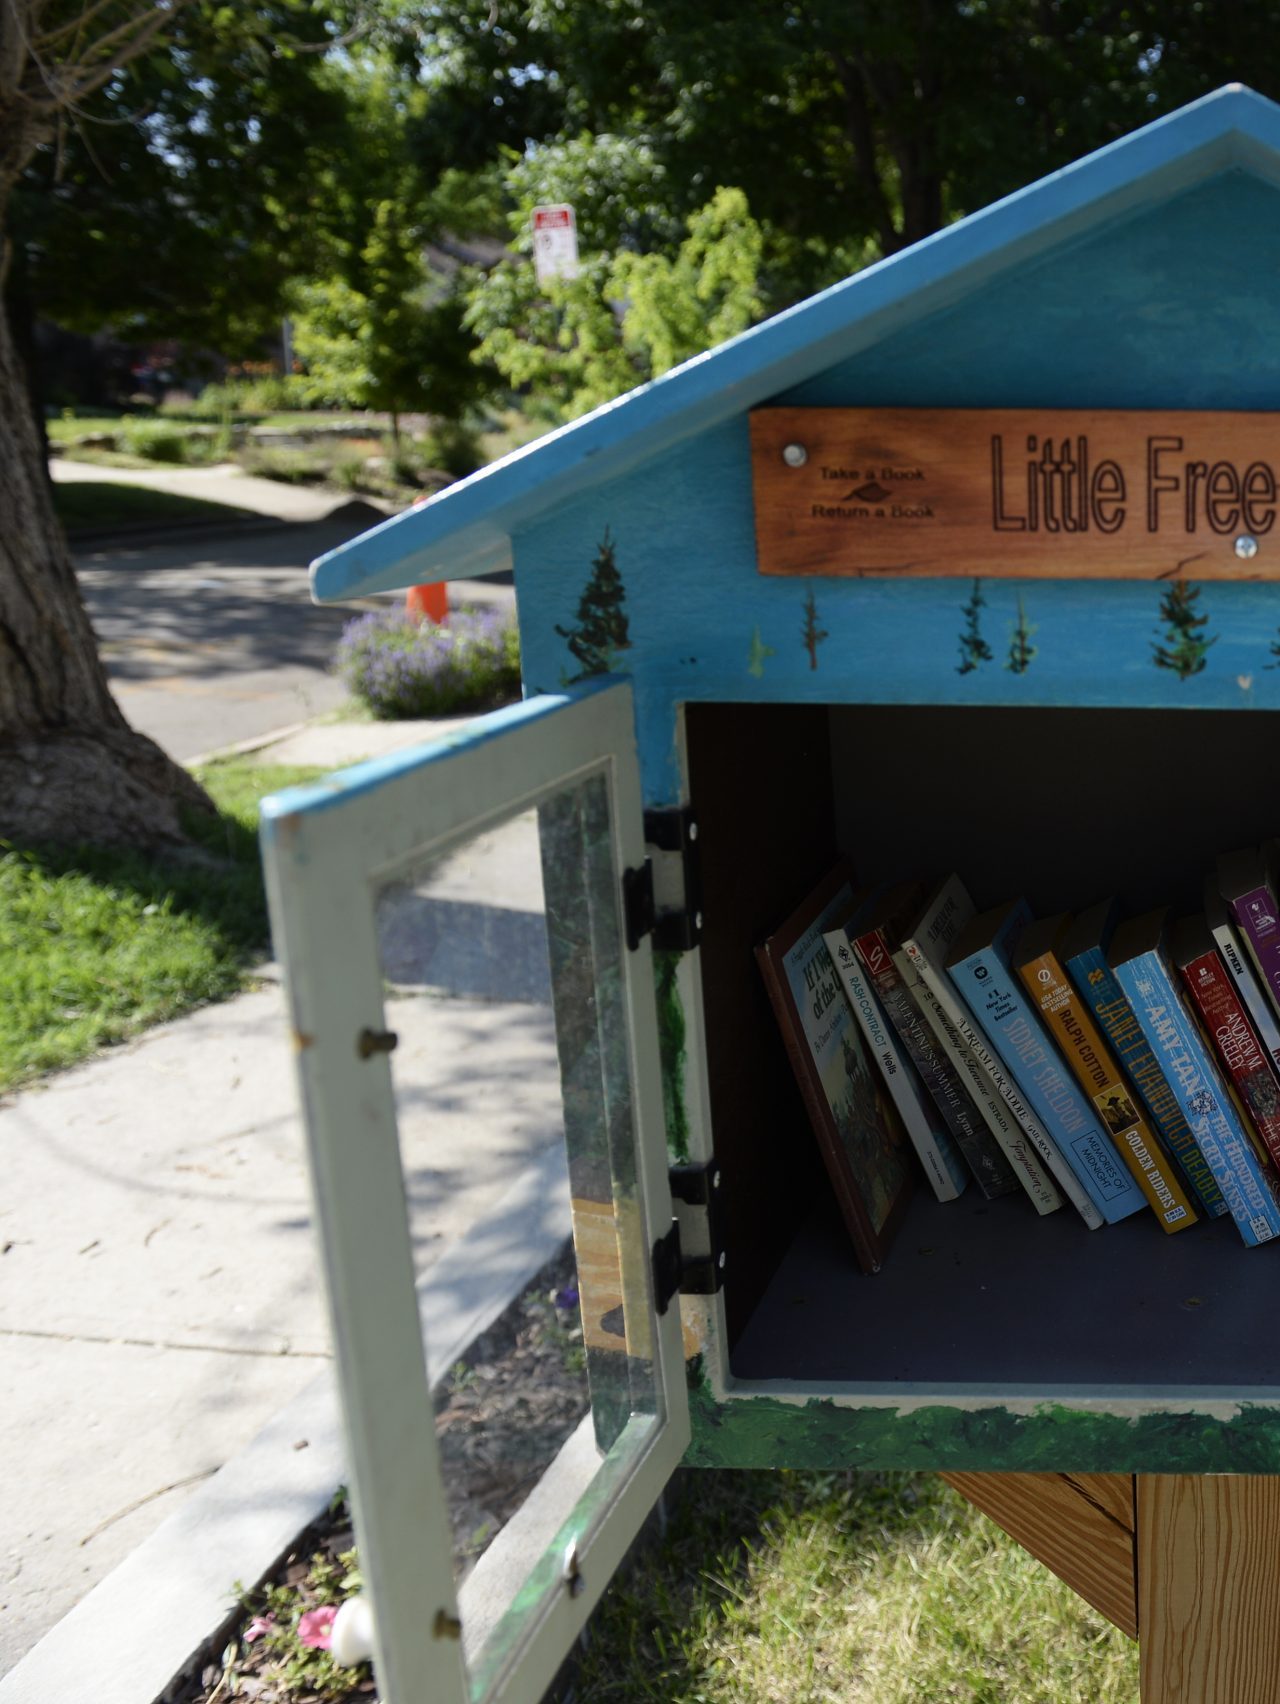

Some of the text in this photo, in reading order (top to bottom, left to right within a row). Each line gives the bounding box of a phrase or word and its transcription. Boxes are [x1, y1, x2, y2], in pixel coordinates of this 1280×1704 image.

[820, 466, 925, 481] Take a Book
[991, 434, 1127, 534] Little
[1147, 436, 1277, 535] Free
[811, 504, 936, 518] Return a Book
[1224, 943, 1244, 975] RIPKEN
[849, 976, 887, 1047] RASH CONTRACT
[1225, 1012, 1260, 1060] ANDREW
[882, 1051, 897, 1075] Wells
[963, 1028, 992, 1065] DREAM
[989, 1065, 1006, 1093] FOR
[1004, 1087, 1029, 1121] ADDIE
[1002, 1015, 1087, 1134] SIDNEY SHELDON
[1059, 1009, 1110, 1088] RALPH COTTON
[1145, 1005, 1206, 1097] AMY TAN
[1216, 1025, 1246, 1070] GREELEY
[929, 1058, 961, 1109] SUMMER
[1095, 997, 1147, 1056] JANET
[1128, 1052, 1196, 1153] EVANOVICH
[956, 1111, 976, 1137] Lynn
[988, 1101, 1009, 1133] ESTRADA
[1263, 1120, 1279, 1145] THE
[1082, 1149, 1112, 1189] MIDNIGHT
[1087, 1136, 1117, 1181] MEMORIES
[1113, 1178, 1125, 1190] OF
[1125, 1130, 1176, 1209] GOLDEN RIDERS
[1181, 1149, 1223, 1203] DEADLY
[1192, 1116, 1227, 1175] SECRET
[1216, 1169, 1251, 1223] SENSES
[1211, 1114, 1233, 1142] THE
[1223, 1138, 1266, 1209] HUNDRED
